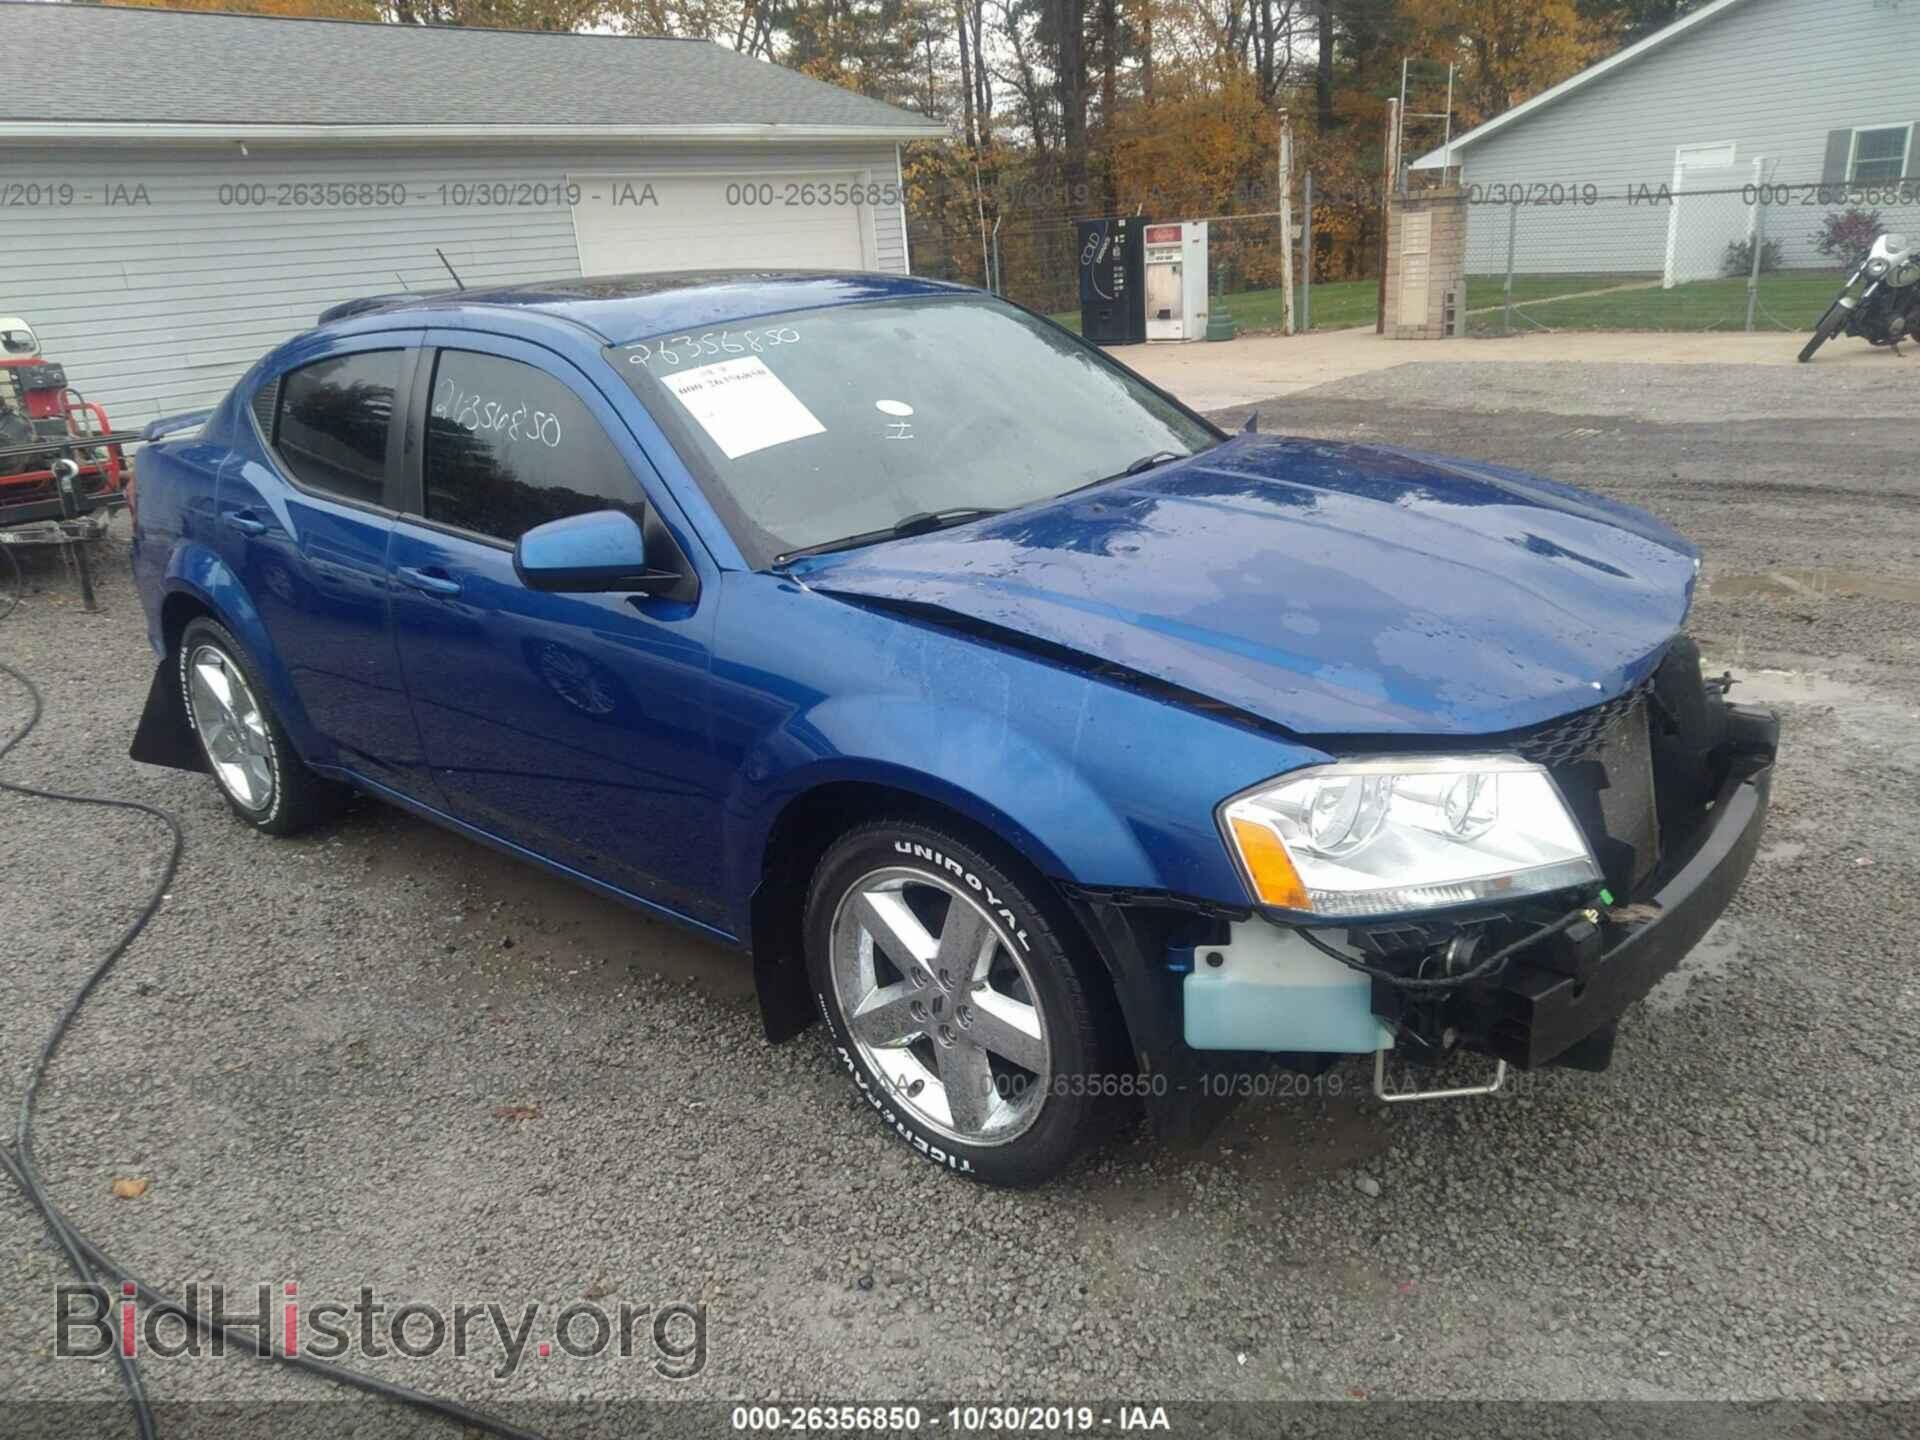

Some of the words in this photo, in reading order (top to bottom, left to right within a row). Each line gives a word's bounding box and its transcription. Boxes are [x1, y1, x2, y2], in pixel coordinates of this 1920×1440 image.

[629, 327, 801, 368] 26356850
[894, 839, 1031, 951] UNIROYAL
[896, 1122, 976, 1174] TIGER
